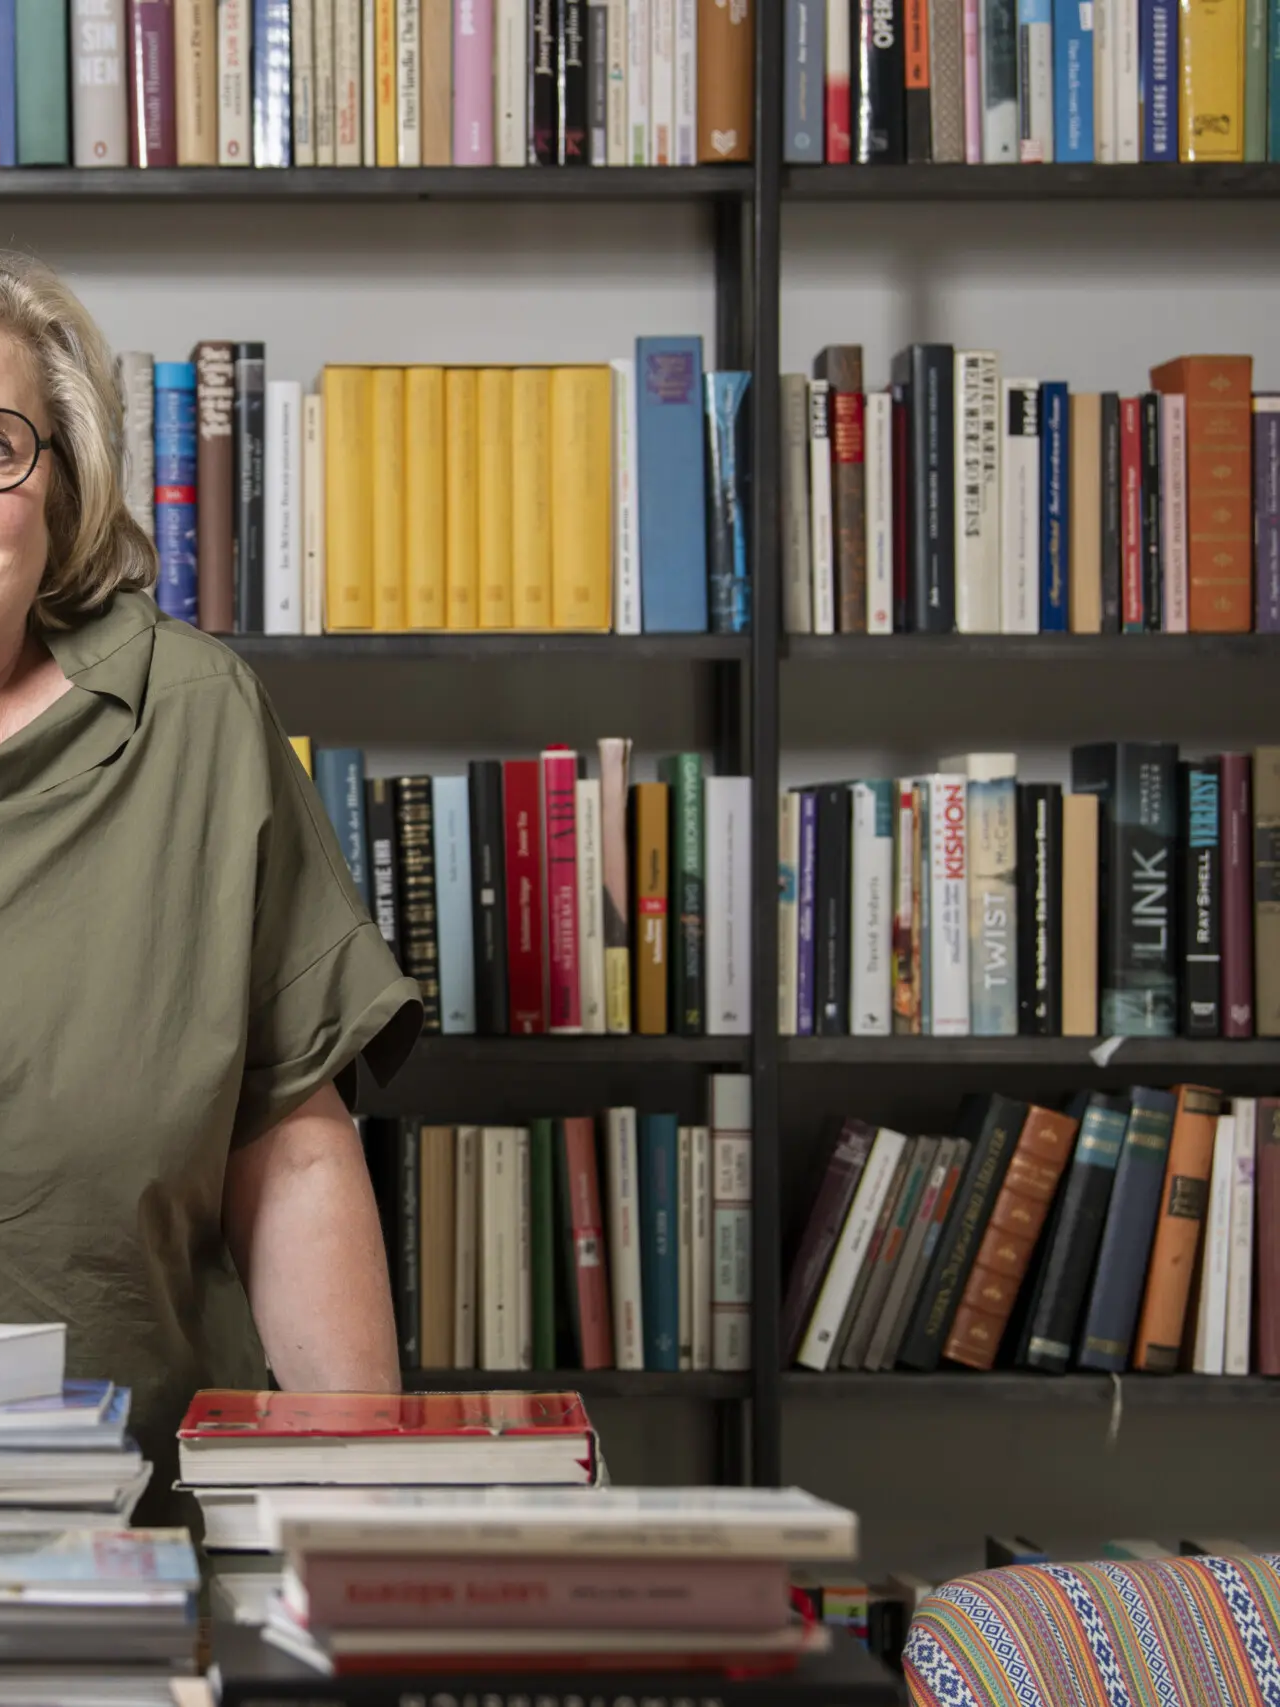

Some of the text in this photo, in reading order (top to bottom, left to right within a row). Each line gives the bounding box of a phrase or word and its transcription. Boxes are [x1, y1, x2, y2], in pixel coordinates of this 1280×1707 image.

[1153, 6, 1167, 153] WOLFGANG HERRNDORF
[965, 457, 980, 480] SO
[346, 763, 358, 807] Blinden
[944, 784, 965, 880] KISHON
[1151, 763, 1162, 825] WASSER
[374, 839, 395, 941] NICHT WIE IHR
[1131, 847, 1168, 952] LINK
[1188, 770, 1218, 943] RAY SHELL VEREIST
[866, 876, 879, 974] David Sedaris
[984, 893, 1007, 989] TWIST
